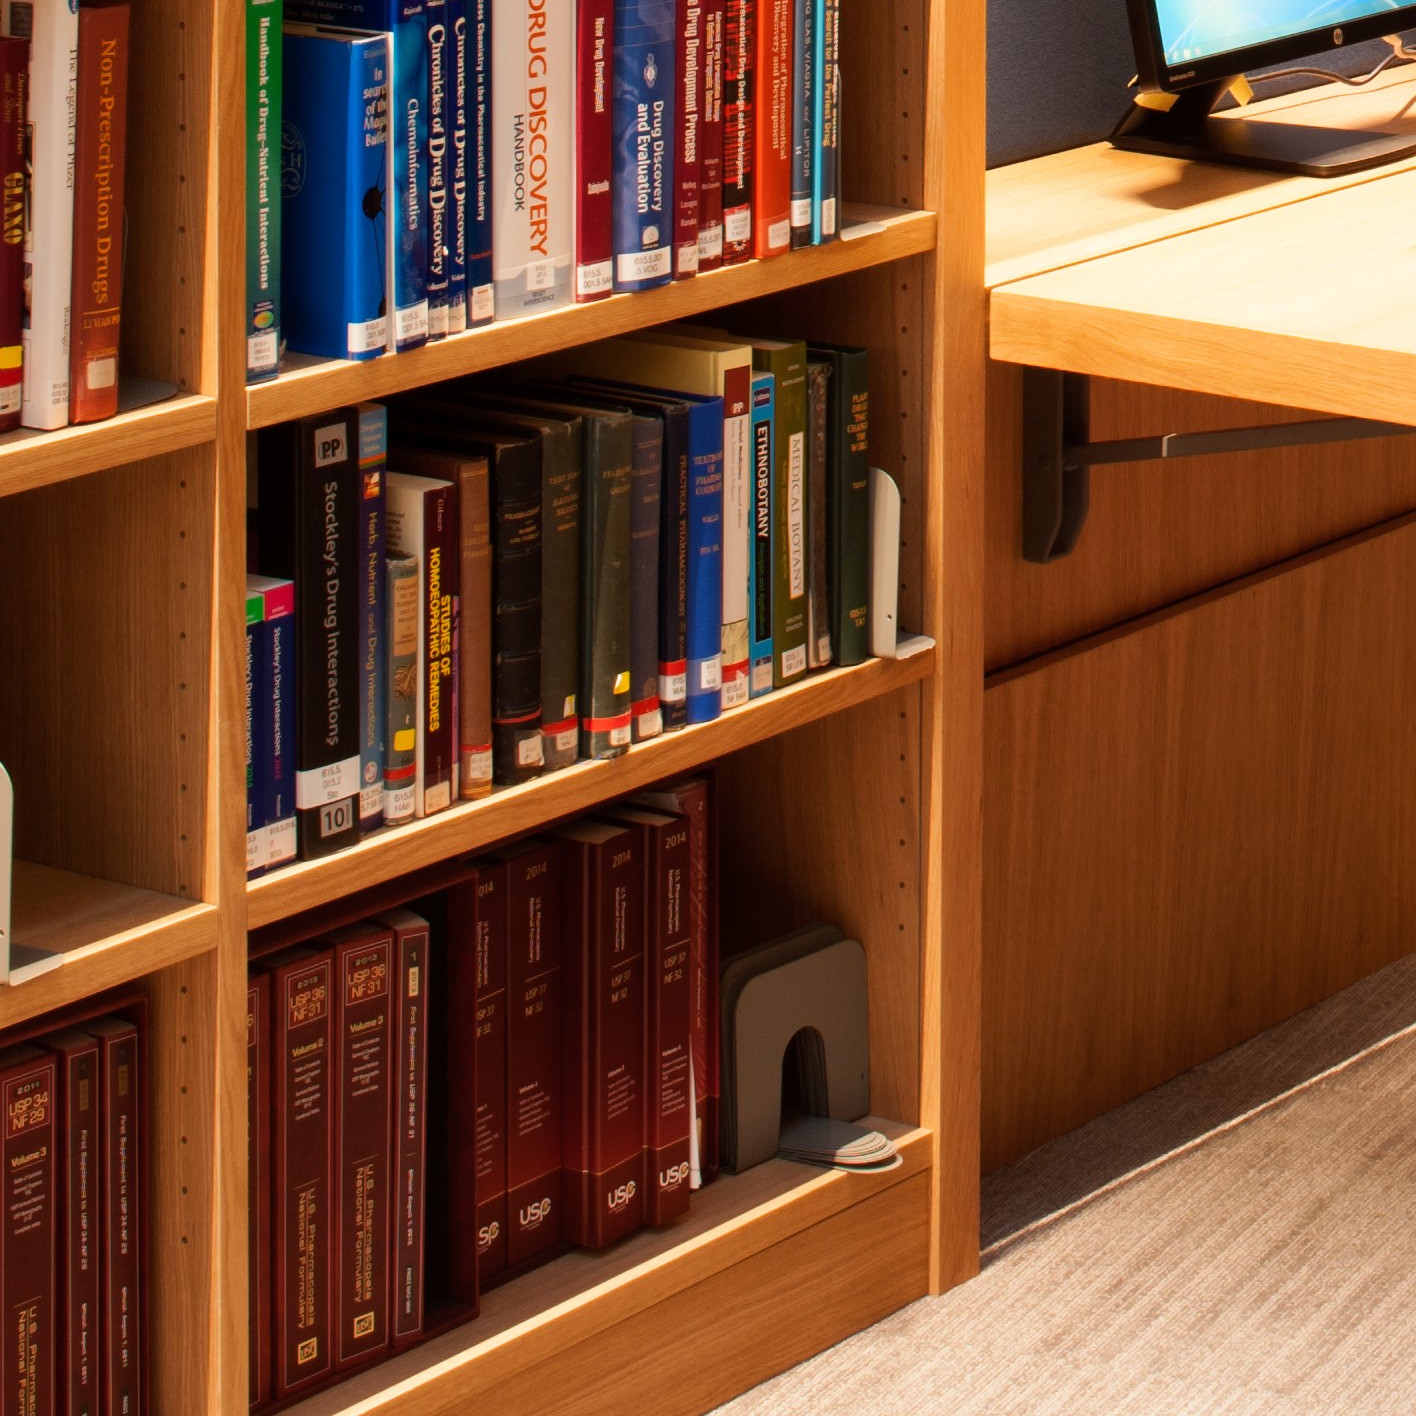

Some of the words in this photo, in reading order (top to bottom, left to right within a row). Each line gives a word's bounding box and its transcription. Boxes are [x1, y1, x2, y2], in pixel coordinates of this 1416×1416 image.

[258, 17, 270, 87] Handbook
[684, 6, 701, 37] Drug
[258, 90, 268, 105] of
[428, 24, 447, 115] Chronicles
[683, 38, 700, 117] Development
[96, 38, 118, 232] Non-Prescription
[432, 117, 442, 132] of
[637, 103, 649, 129] and
[650, 100, 664, 139] Drug
[683, 114, 698, 163] Process
[257, 107, 270, 204] Drug-Nutrient
[407, 98, 420, 231] Chemoinformatics
[429, 137, 447, 186] Drug
[513, 114, 526, 212] HANDBOOK
[528, 86, 548, 256] DISCOVERY
[637, 131, 651, 213] Evaluation
[650, 142, 665, 213] Discovery
[3, 171, 25, 246] GLAXO
[429, 189, 448, 274] Discovery
[93, 235, 113, 305] Drugs
[258, 207, 270, 290] Interactions
[757, 426, 769, 537] ETHNOBOTANY
[790, 438, 801, 516] MEDICAL
[323, 481, 340, 576] Stockley's
[790, 521, 800, 592] BOTANY
[324, 578, 341, 628] Drug
[429, 548, 441, 660] HOMOEOPATHIC
[441, 594, 451, 651] STUDIES
[327, 632, 341, 746] Interactions
[429, 662, 441, 732] REMEDIES
[440, 655, 451, 677] OF
[324, 807, 344, 831] 10
[665, 831, 686, 849] 2014
[526, 862, 547, 881] 2014
[612, 849, 631, 868] 2014
